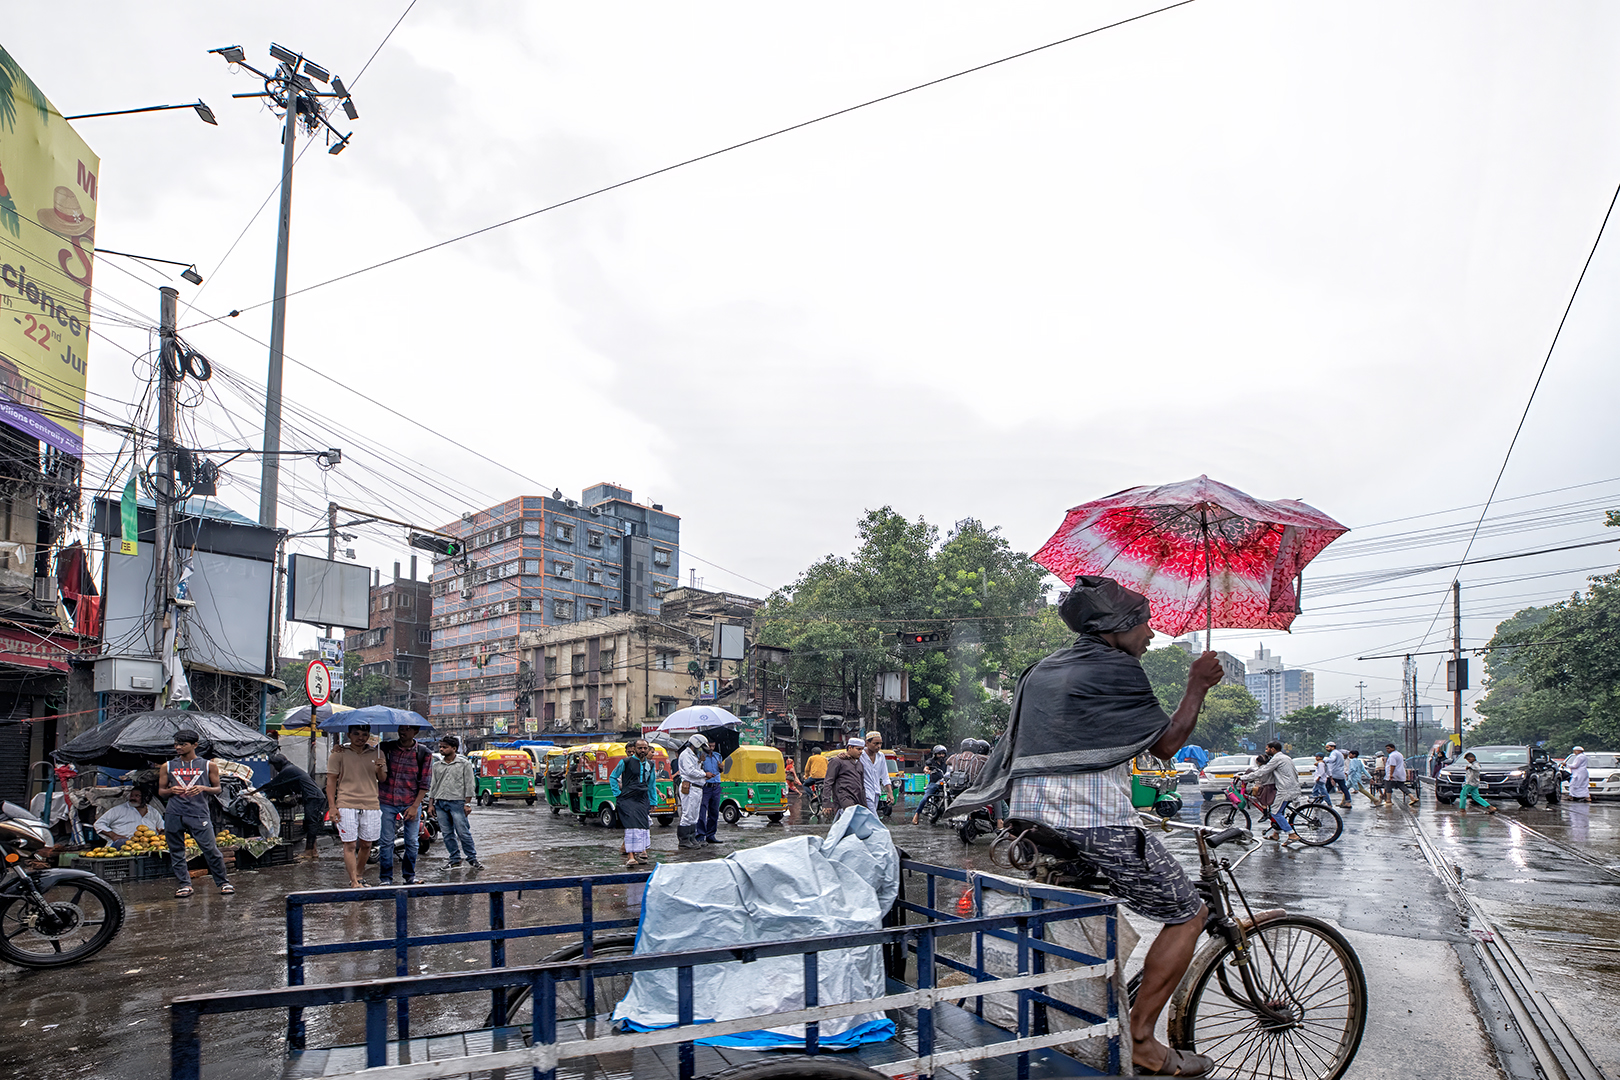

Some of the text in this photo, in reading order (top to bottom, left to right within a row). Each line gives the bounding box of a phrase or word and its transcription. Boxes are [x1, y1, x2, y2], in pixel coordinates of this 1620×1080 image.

[77, 158, 96, 201] M
[1, 262, 81, 337] cience
[174, 767, 200, 776] SKATE
